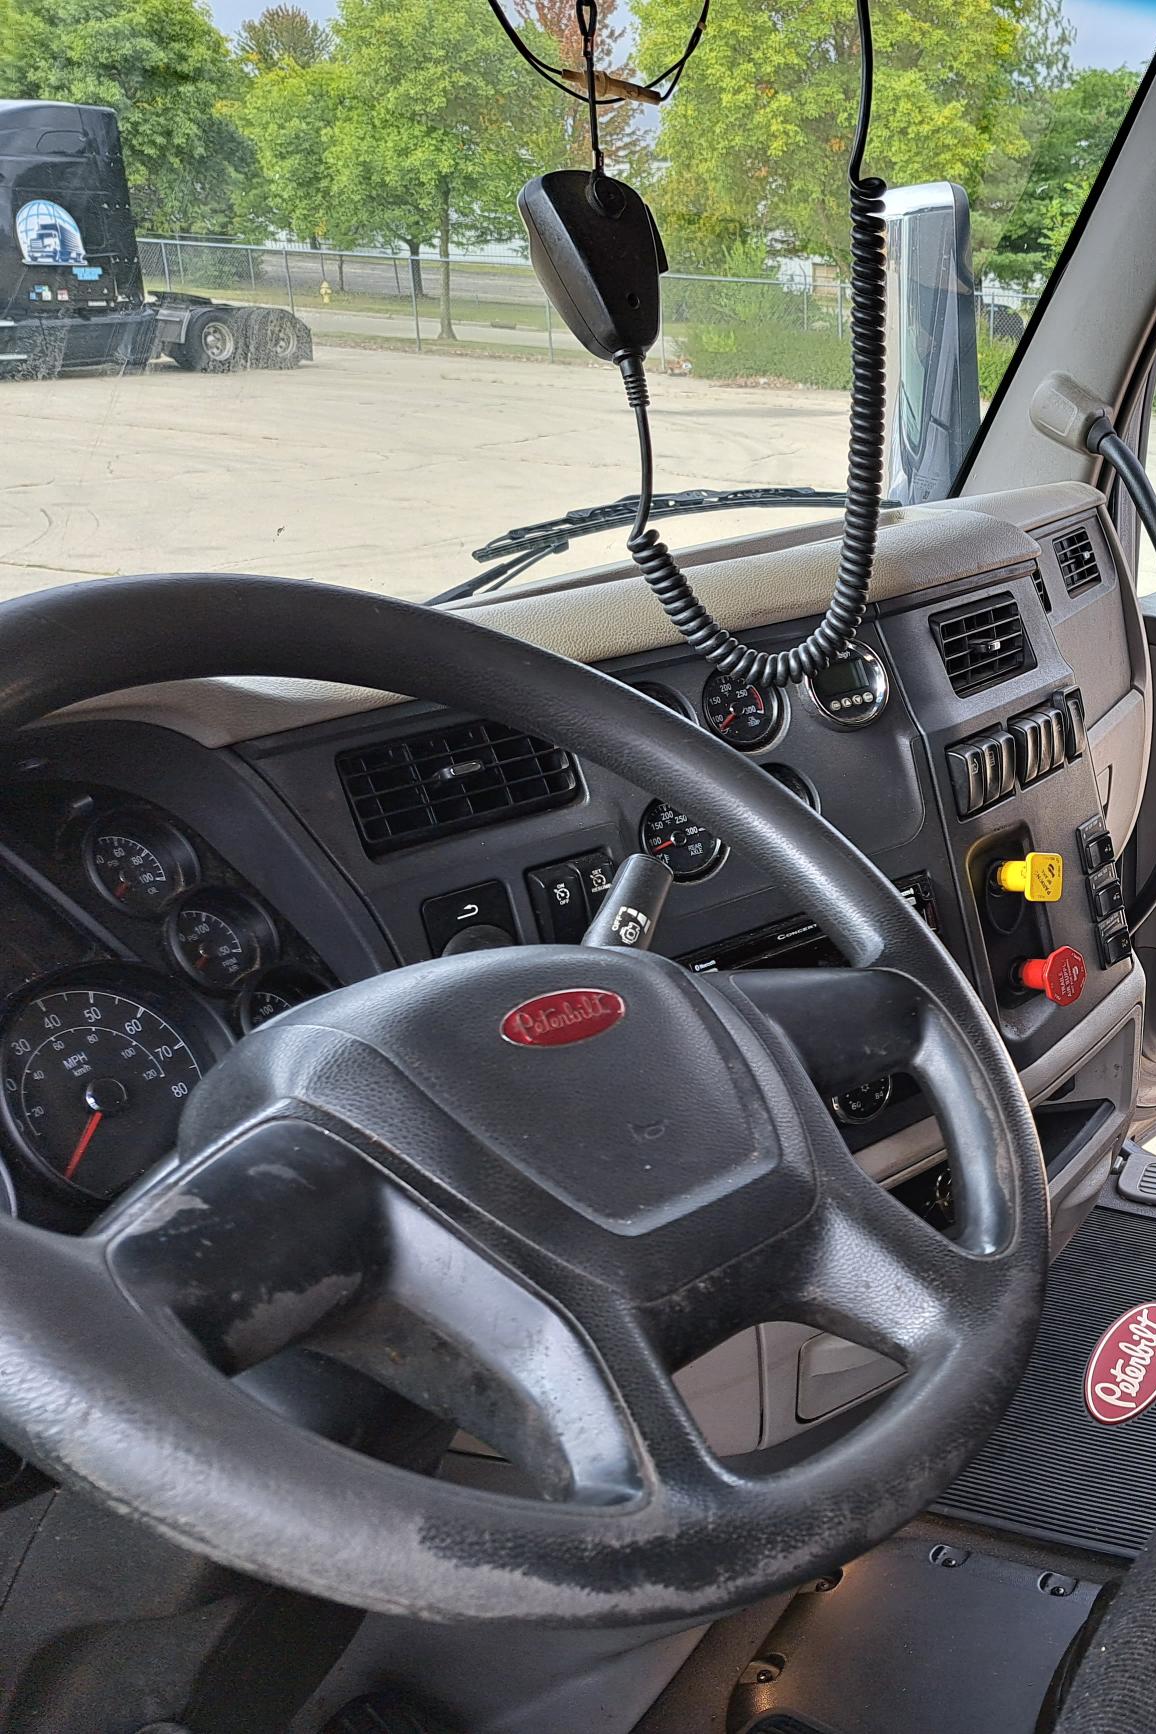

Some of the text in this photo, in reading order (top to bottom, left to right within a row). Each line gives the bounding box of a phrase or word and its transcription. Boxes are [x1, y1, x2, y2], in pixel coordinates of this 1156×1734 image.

[720, 683, 732, 693] 200
[736, 689, 748, 699] 250
[709, 696, 721, 706] 150
[661, 810, 674, 821] 200
[674, 814, 688, 824] 250
[651, 821, 664, 831] 150
[685, 826, 698, 836] 300
[649, 836, 662, 847] 100
[690, 848, 704, 856] AXLE
[139, 872, 154, 884] 100
[612, 914, 622, 931] OFF
[194, 923, 210, 935] 100
[83, 1006, 101, 1023] 50
[259, 1004, 274, 1016] 100
[44, 1014, 61, 1030] 40
[514, 993, 612, 1043] Peterbilt
[124, 1019, 142, 1035] 60
[86, 1033, 99, 1044] 80
[11, 1038, 31, 1056] 30
[52, 1040, 65, 1051] 60
[121, 1047, 136, 1059] 100
[154, 1045, 173, 1060] 70
[62, 1051, 88, 1070] MPH
[33, 1070, 45, 1081] 40
[72, 1064, 92, 1077] km/h
[142, 1068, 158, 1080] 120
[171, 1082, 188, 1098] 80
[31, 1105, 45, 1118] 20
